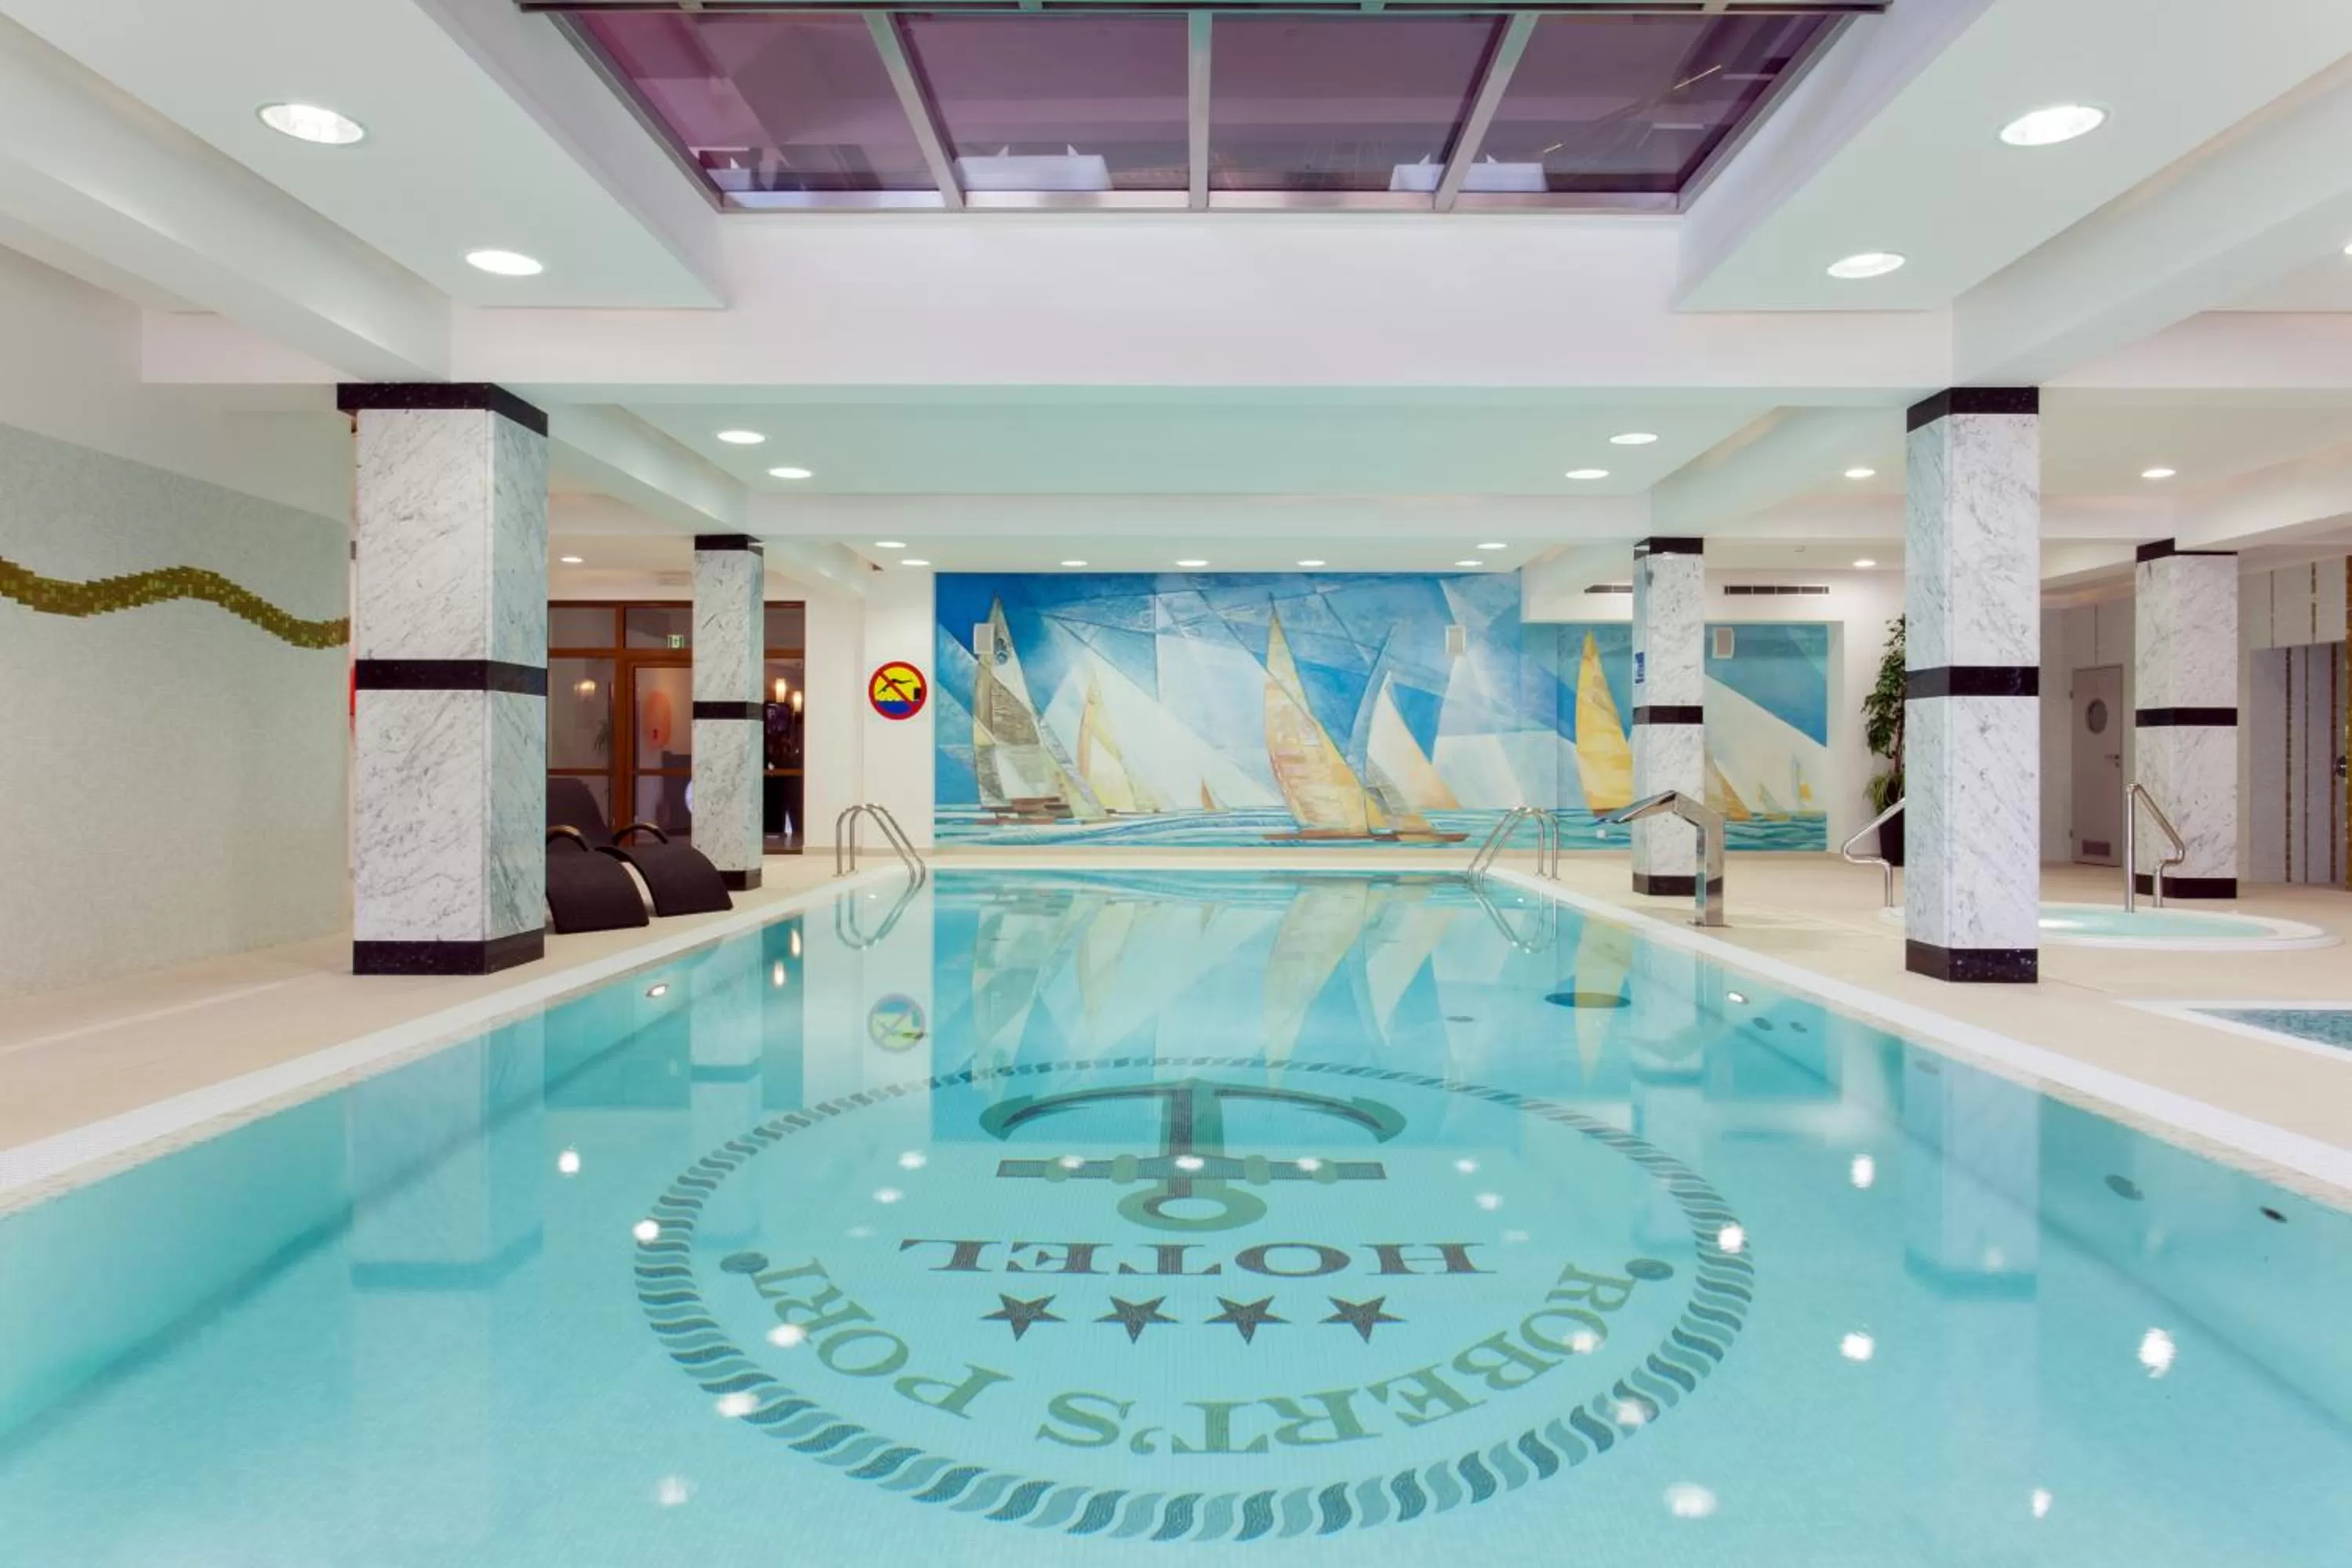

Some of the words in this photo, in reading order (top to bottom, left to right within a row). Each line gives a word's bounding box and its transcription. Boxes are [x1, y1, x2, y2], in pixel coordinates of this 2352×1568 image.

[750, 1257, 1014, 1420] PORT
[898, 1239, 1498, 1276] HOTEL
[1035, 1262, 1637, 1455] ROBERT'S
